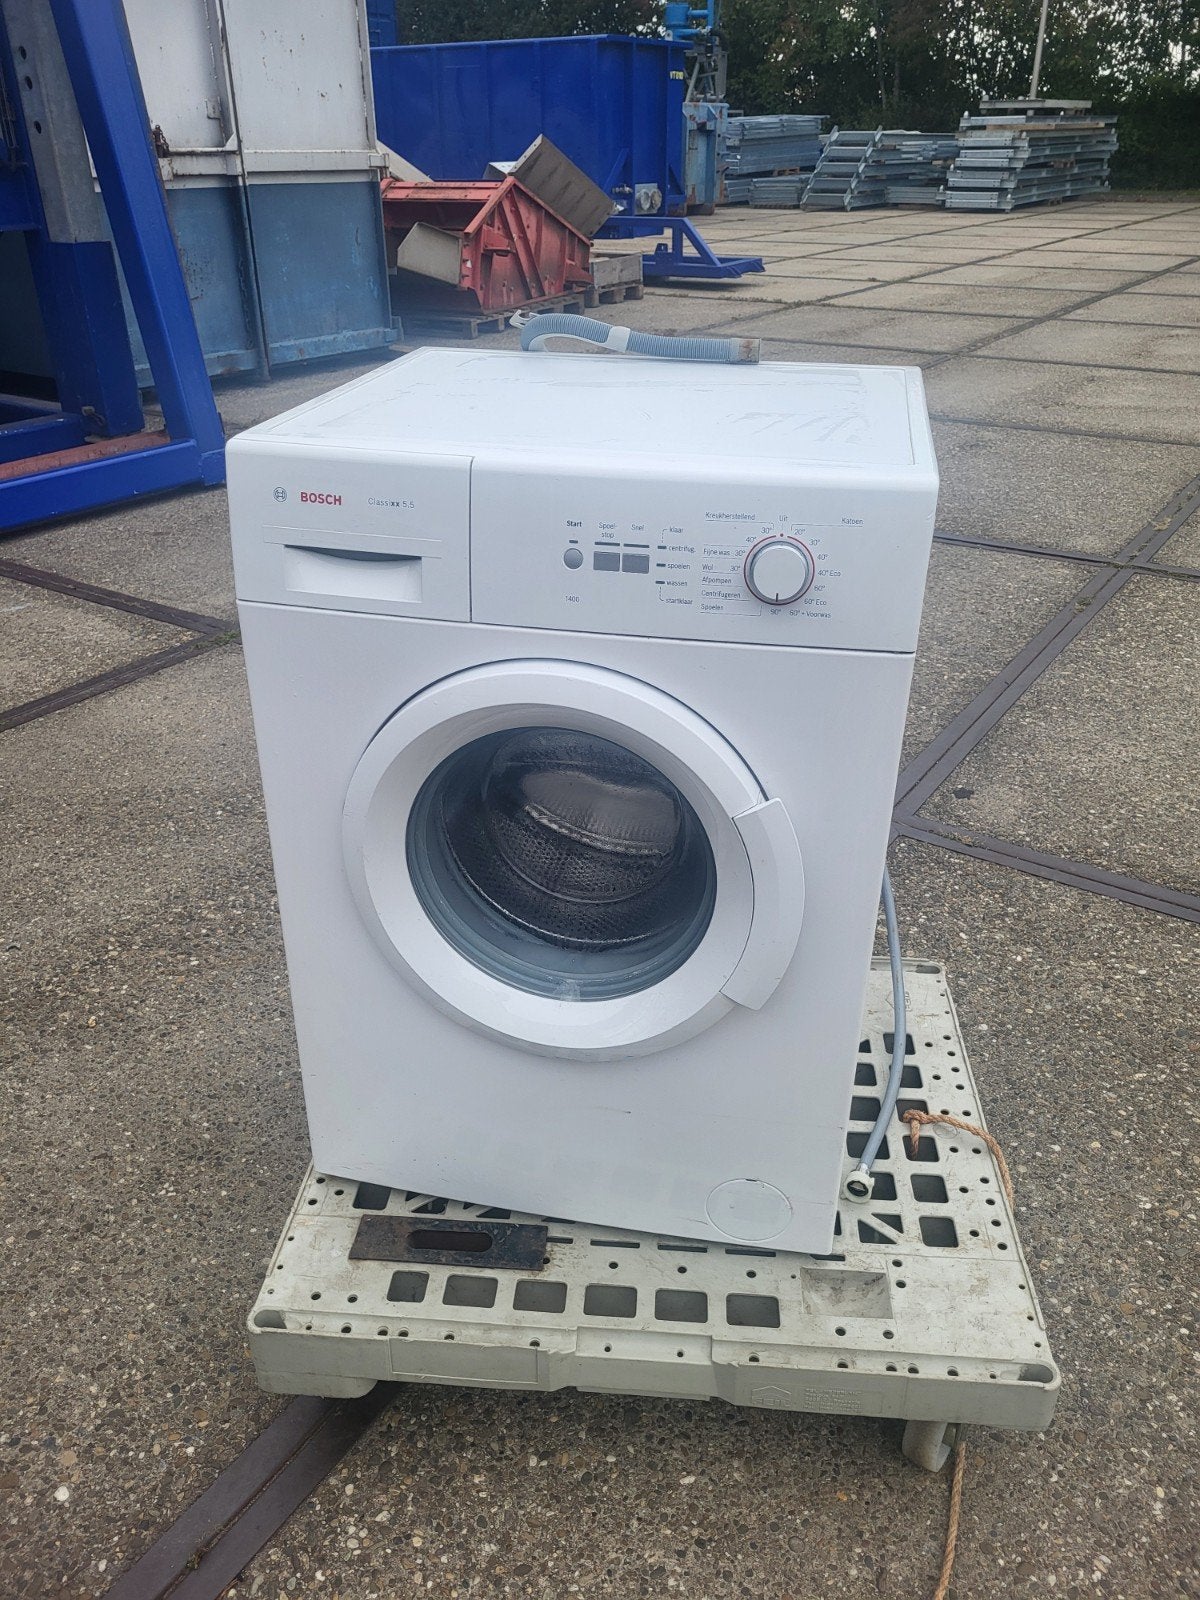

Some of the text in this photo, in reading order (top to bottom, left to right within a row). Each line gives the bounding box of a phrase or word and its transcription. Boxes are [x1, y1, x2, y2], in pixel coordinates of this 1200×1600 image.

[300, 491, 342, 506] BOSCH
[367, 497, 400, 508] Classixx
[705, 512, 755, 521] Kreukherstellend
[566, 519, 582, 527] Start
[841, 517, 863, 525] Katoen
[760, 526, 772, 534] 30°
[703, 548, 718, 556] Fijne
[702, 563, 714, 571] Wol
[702, 576, 732, 585] Afpompen
[701, 590, 741, 599] Centrifugeren
[700, 603, 724, 611] Spoelen
[806, 610, 832, 619] Voorwas
